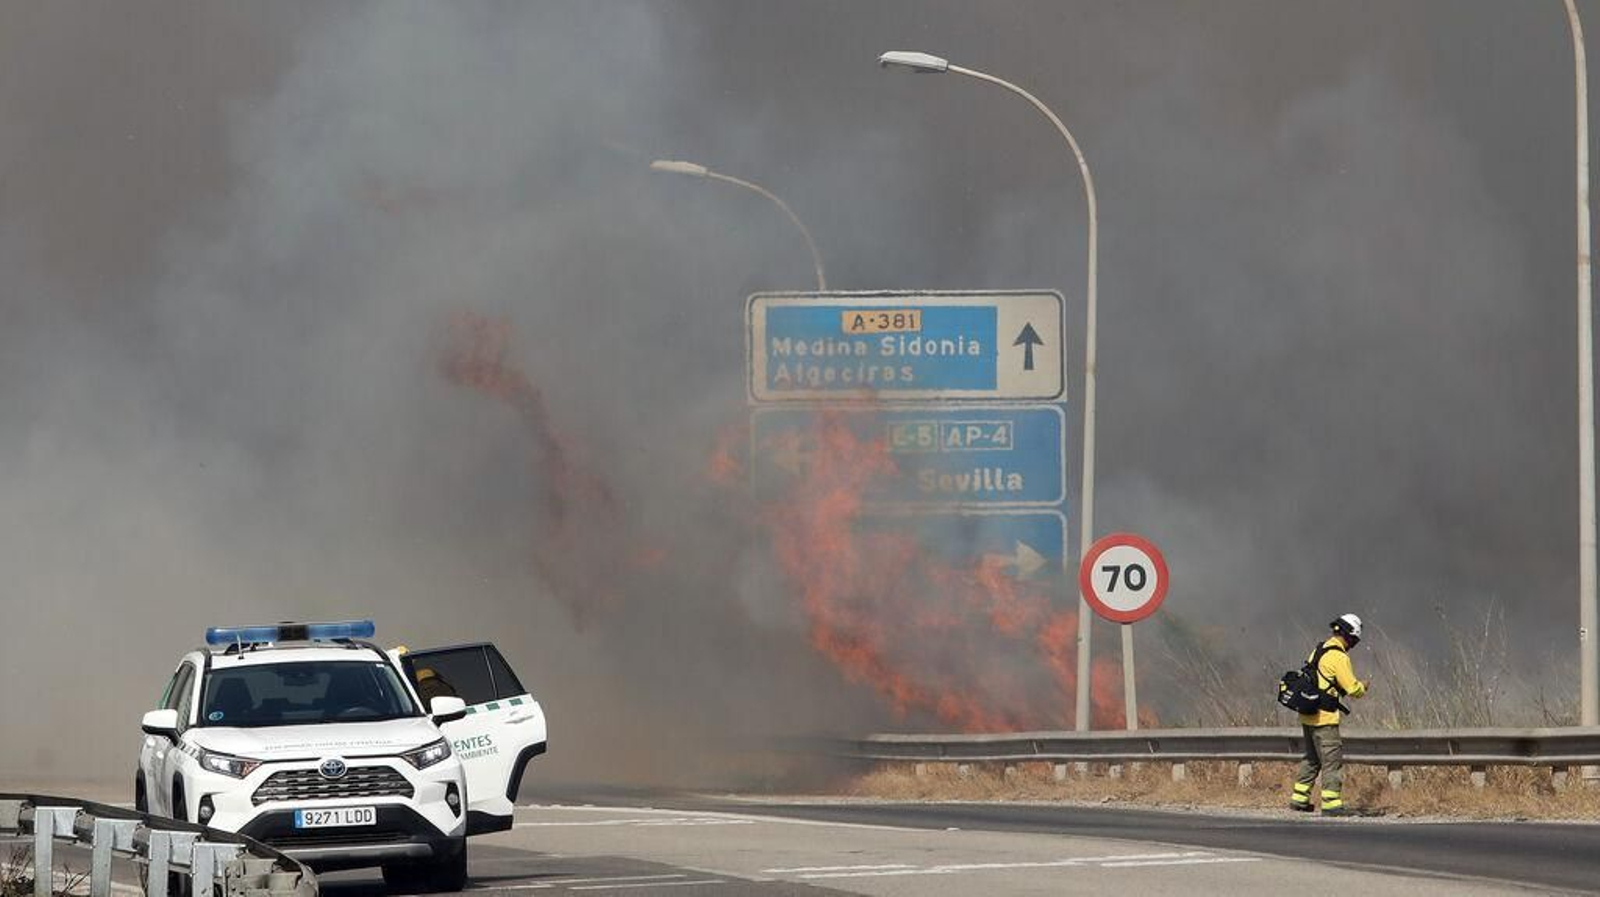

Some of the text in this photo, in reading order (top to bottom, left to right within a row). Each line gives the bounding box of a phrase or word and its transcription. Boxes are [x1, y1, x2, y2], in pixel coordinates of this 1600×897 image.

[772, 336, 981, 356] Medina Sidonia
[773, 362, 914, 386] Algeciras
[947, 425, 1008, 447] AP-4
[918, 468, 1023, 491] Sevilla
[1102, 564, 1146, 592] 70
[451, 734, 492, 751] ENTES
[305, 809, 373, 825] 9271 LDD
